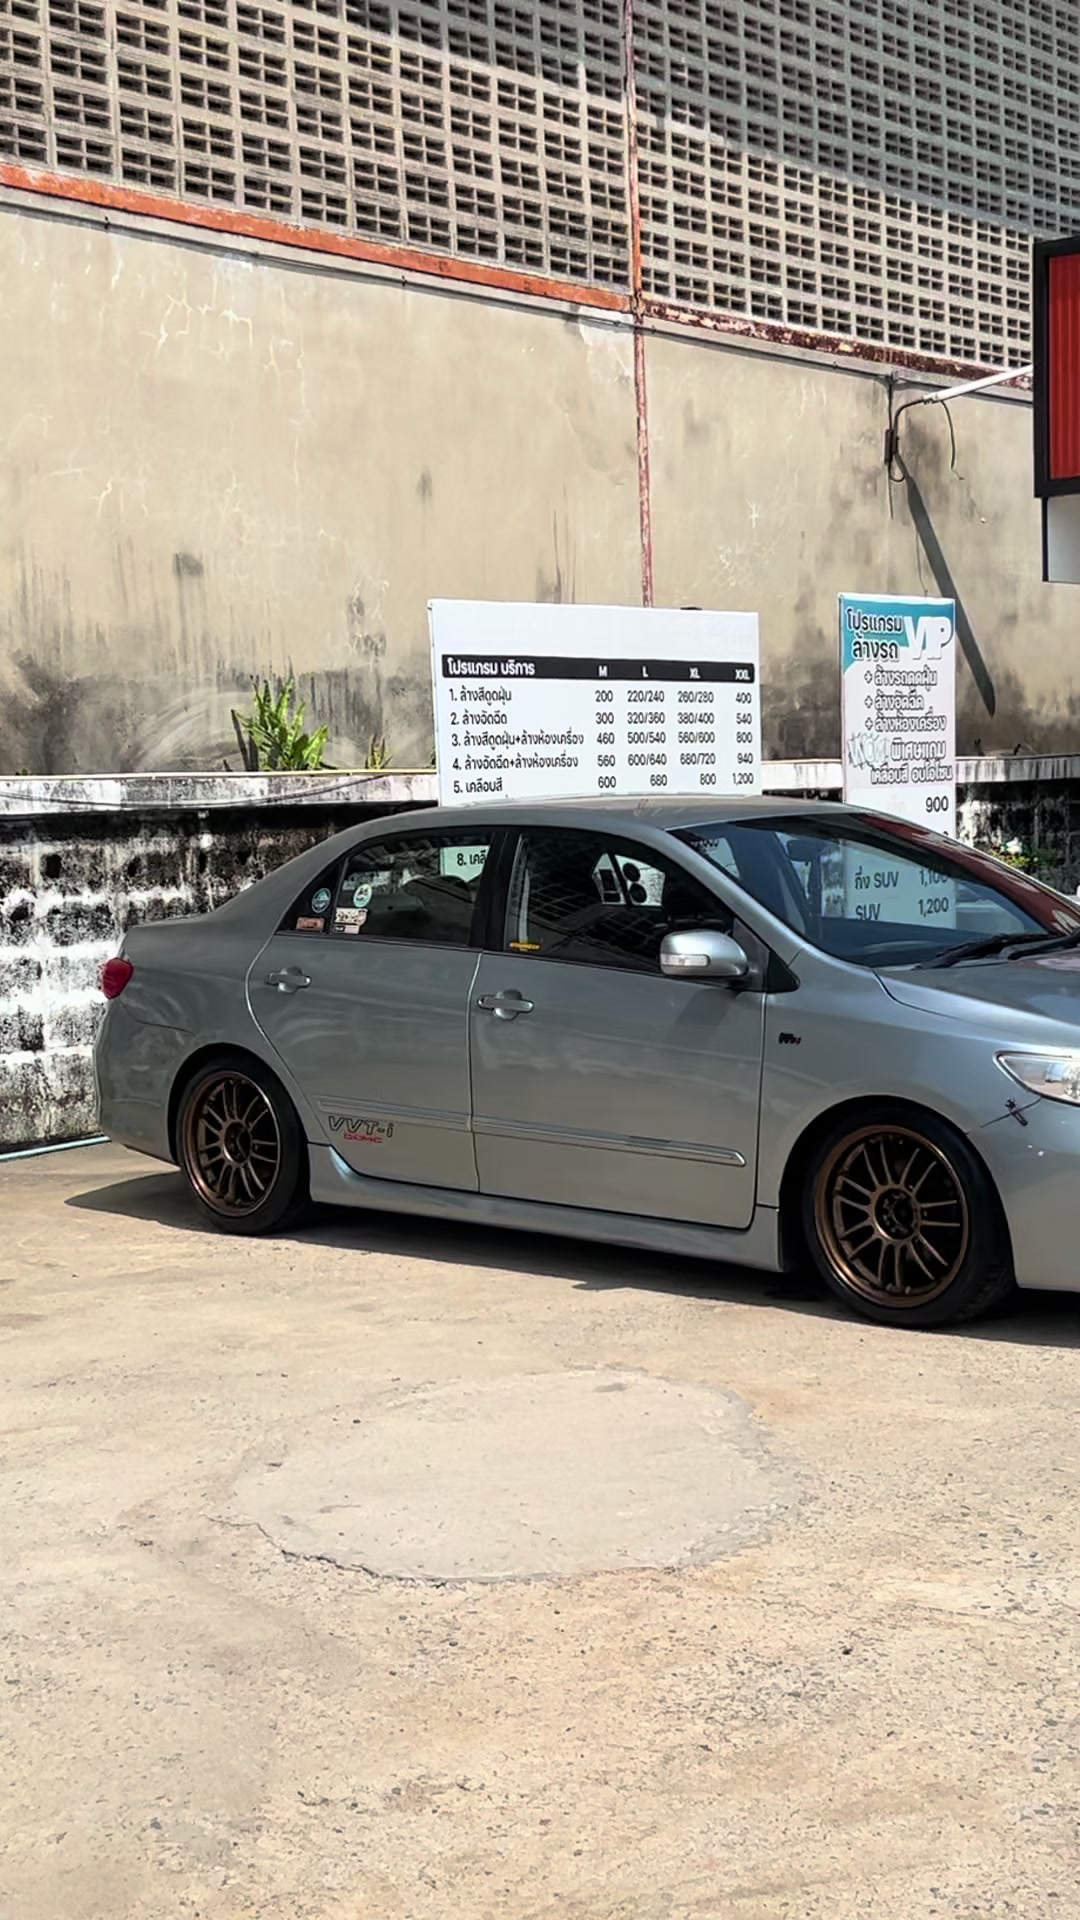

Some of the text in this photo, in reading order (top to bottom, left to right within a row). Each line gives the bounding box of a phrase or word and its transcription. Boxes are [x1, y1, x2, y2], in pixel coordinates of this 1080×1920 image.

[847, 608, 903, 633] โปรแกรม
[852, 633, 898, 659] ล้างรถ
[903, 616, 951, 660] VIP
[447, 656, 750, 680] โปรแกรม บริการ M L XL XXL
[449, 688, 457, 701] 1.
[595, 690, 614, 703] 200
[627, 690, 665, 703] 220/240
[677, 691, 714, 703] 260/280
[735, 692, 752, 704] 400
[450, 712, 460, 725] 2.
[595, 712, 615, 725] 300
[627, 712, 666, 725] 320/360
[677, 712, 715, 725] 380/400
[736, 712, 752, 725] 540
[452, 733, 461, 747] 3.
[596, 732, 615, 745] 460
[627, 731, 666, 744] 500/540
[678, 731, 715, 744] 560/600
[736, 731, 753, 744] 800
[452, 758, 462, 771] 4.
[597, 755, 616, 767] 560
[628, 753, 667, 766] 600/640
[680, 752, 716, 765] 680/720
[737, 752, 754, 764] 940
[453, 780, 463, 794] 5.
[598, 776, 617, 789] 600
[650, 774, 668, 787] 680
[700, 773, 717, 785] 800
[732, 772, 754, 786] 1,200
[925, 795, 949, 813] 900
[456, 853, 467, 866] 8.
[873, 871, 899, 889] SUV
[855, 897, 949, 921] SUV 1,200
